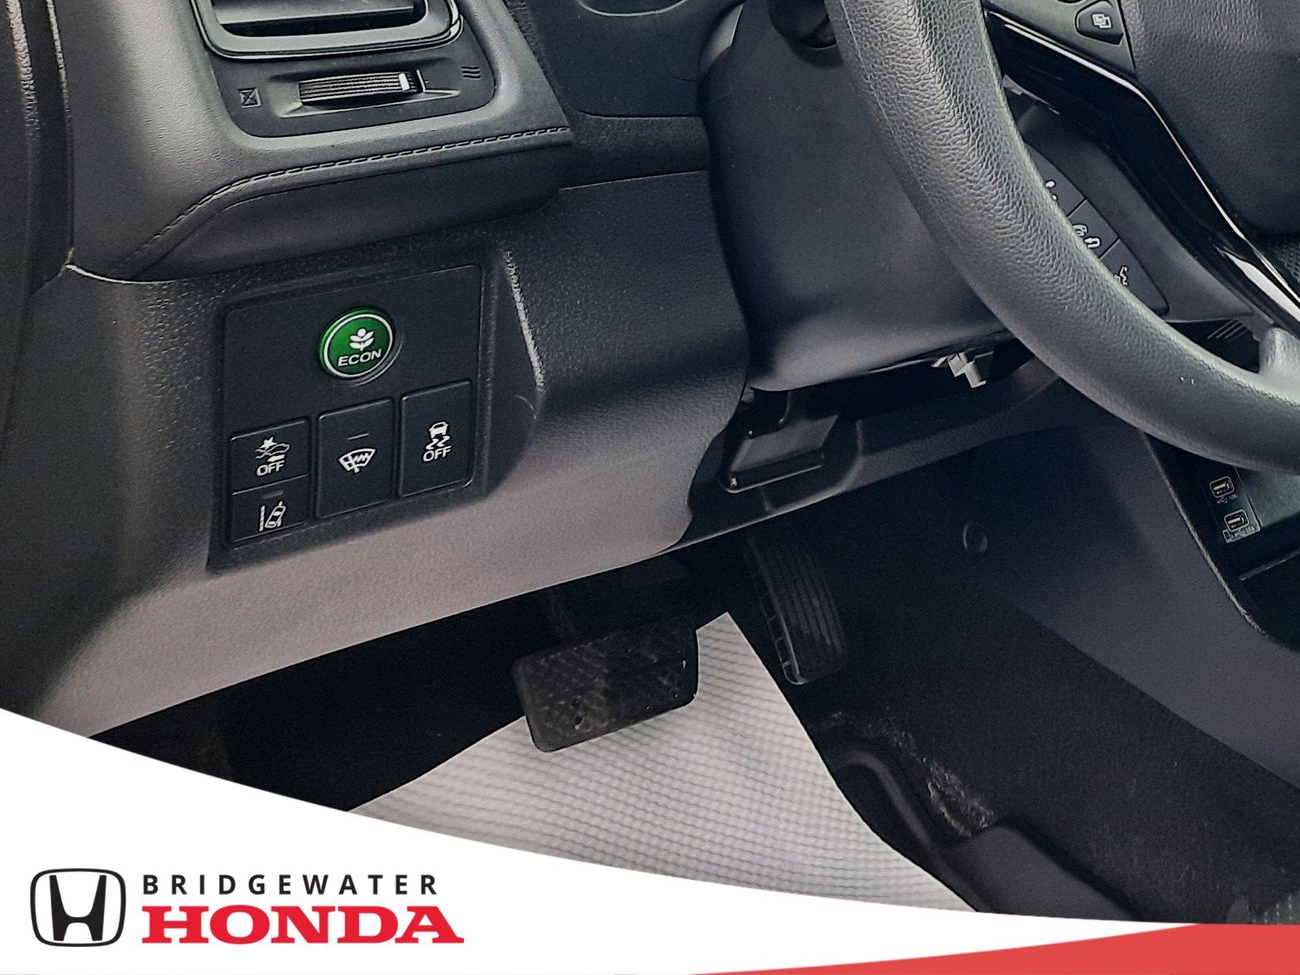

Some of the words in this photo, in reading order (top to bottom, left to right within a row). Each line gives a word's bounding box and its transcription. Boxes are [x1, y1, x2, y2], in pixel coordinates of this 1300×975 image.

[338, 349, 382, 367] ECON
[423, 445, 452, 463] OFF
[256, 460, 286, 477] OFF
